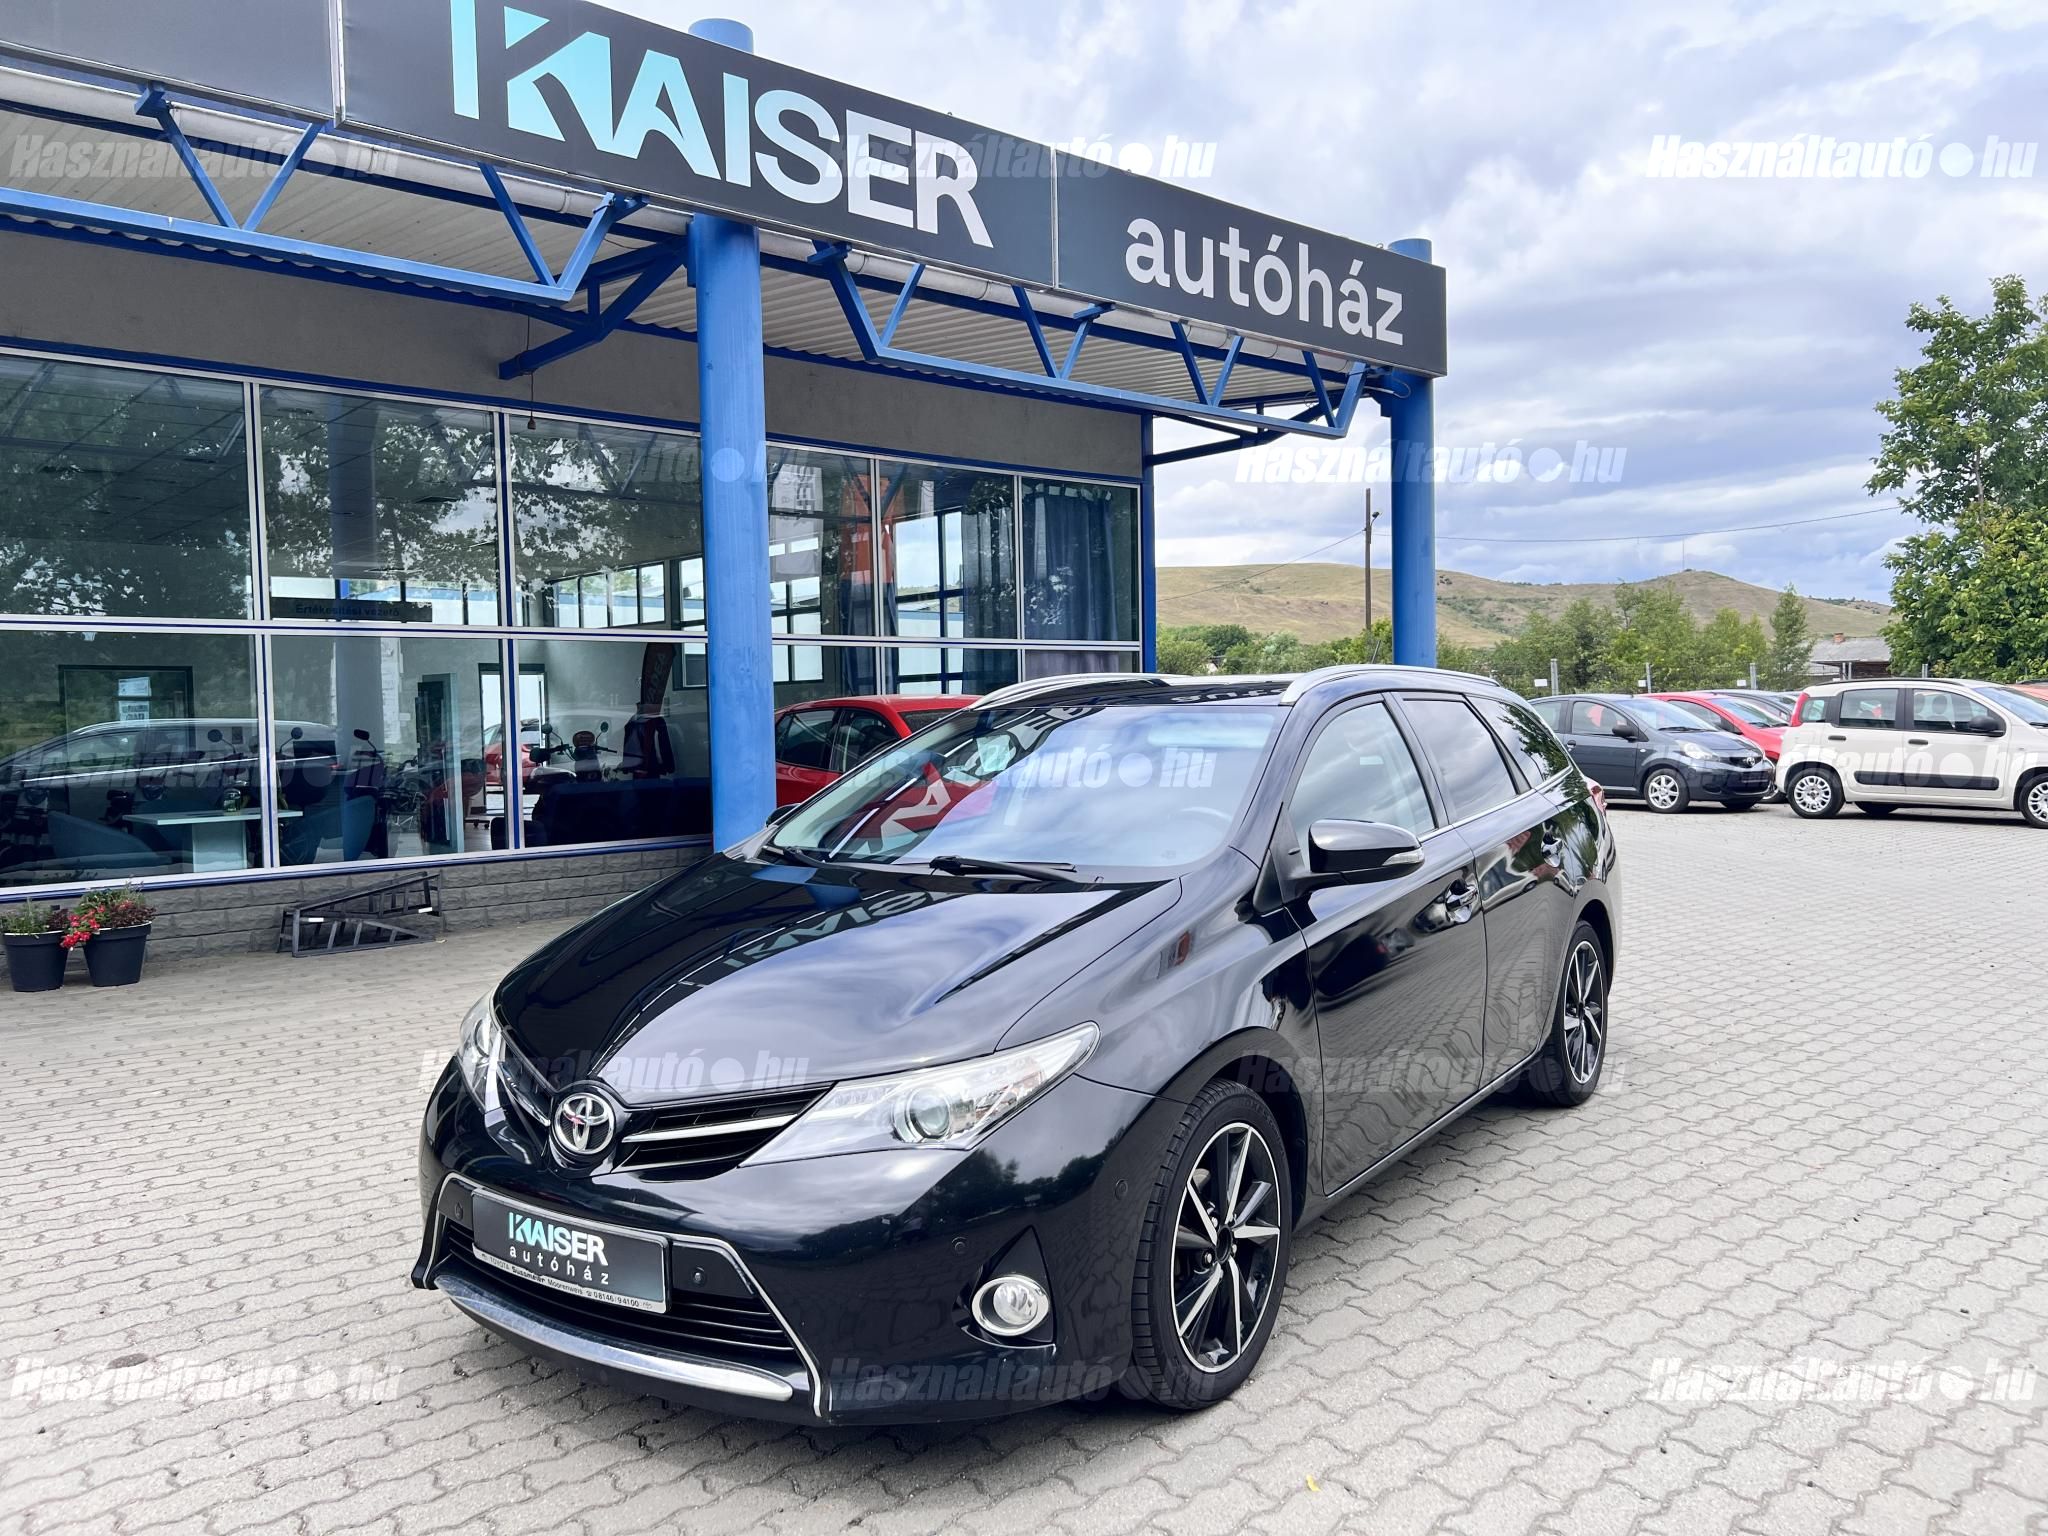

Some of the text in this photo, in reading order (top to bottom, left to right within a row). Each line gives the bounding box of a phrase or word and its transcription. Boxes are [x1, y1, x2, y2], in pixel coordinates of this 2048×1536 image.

[450, 0, 994, 249] KAISER
[1126, 218, 1403, 346] autóház
[508, 1212, 608, 1266] KAISER
[509, 1246, 609, 1285] autóház
